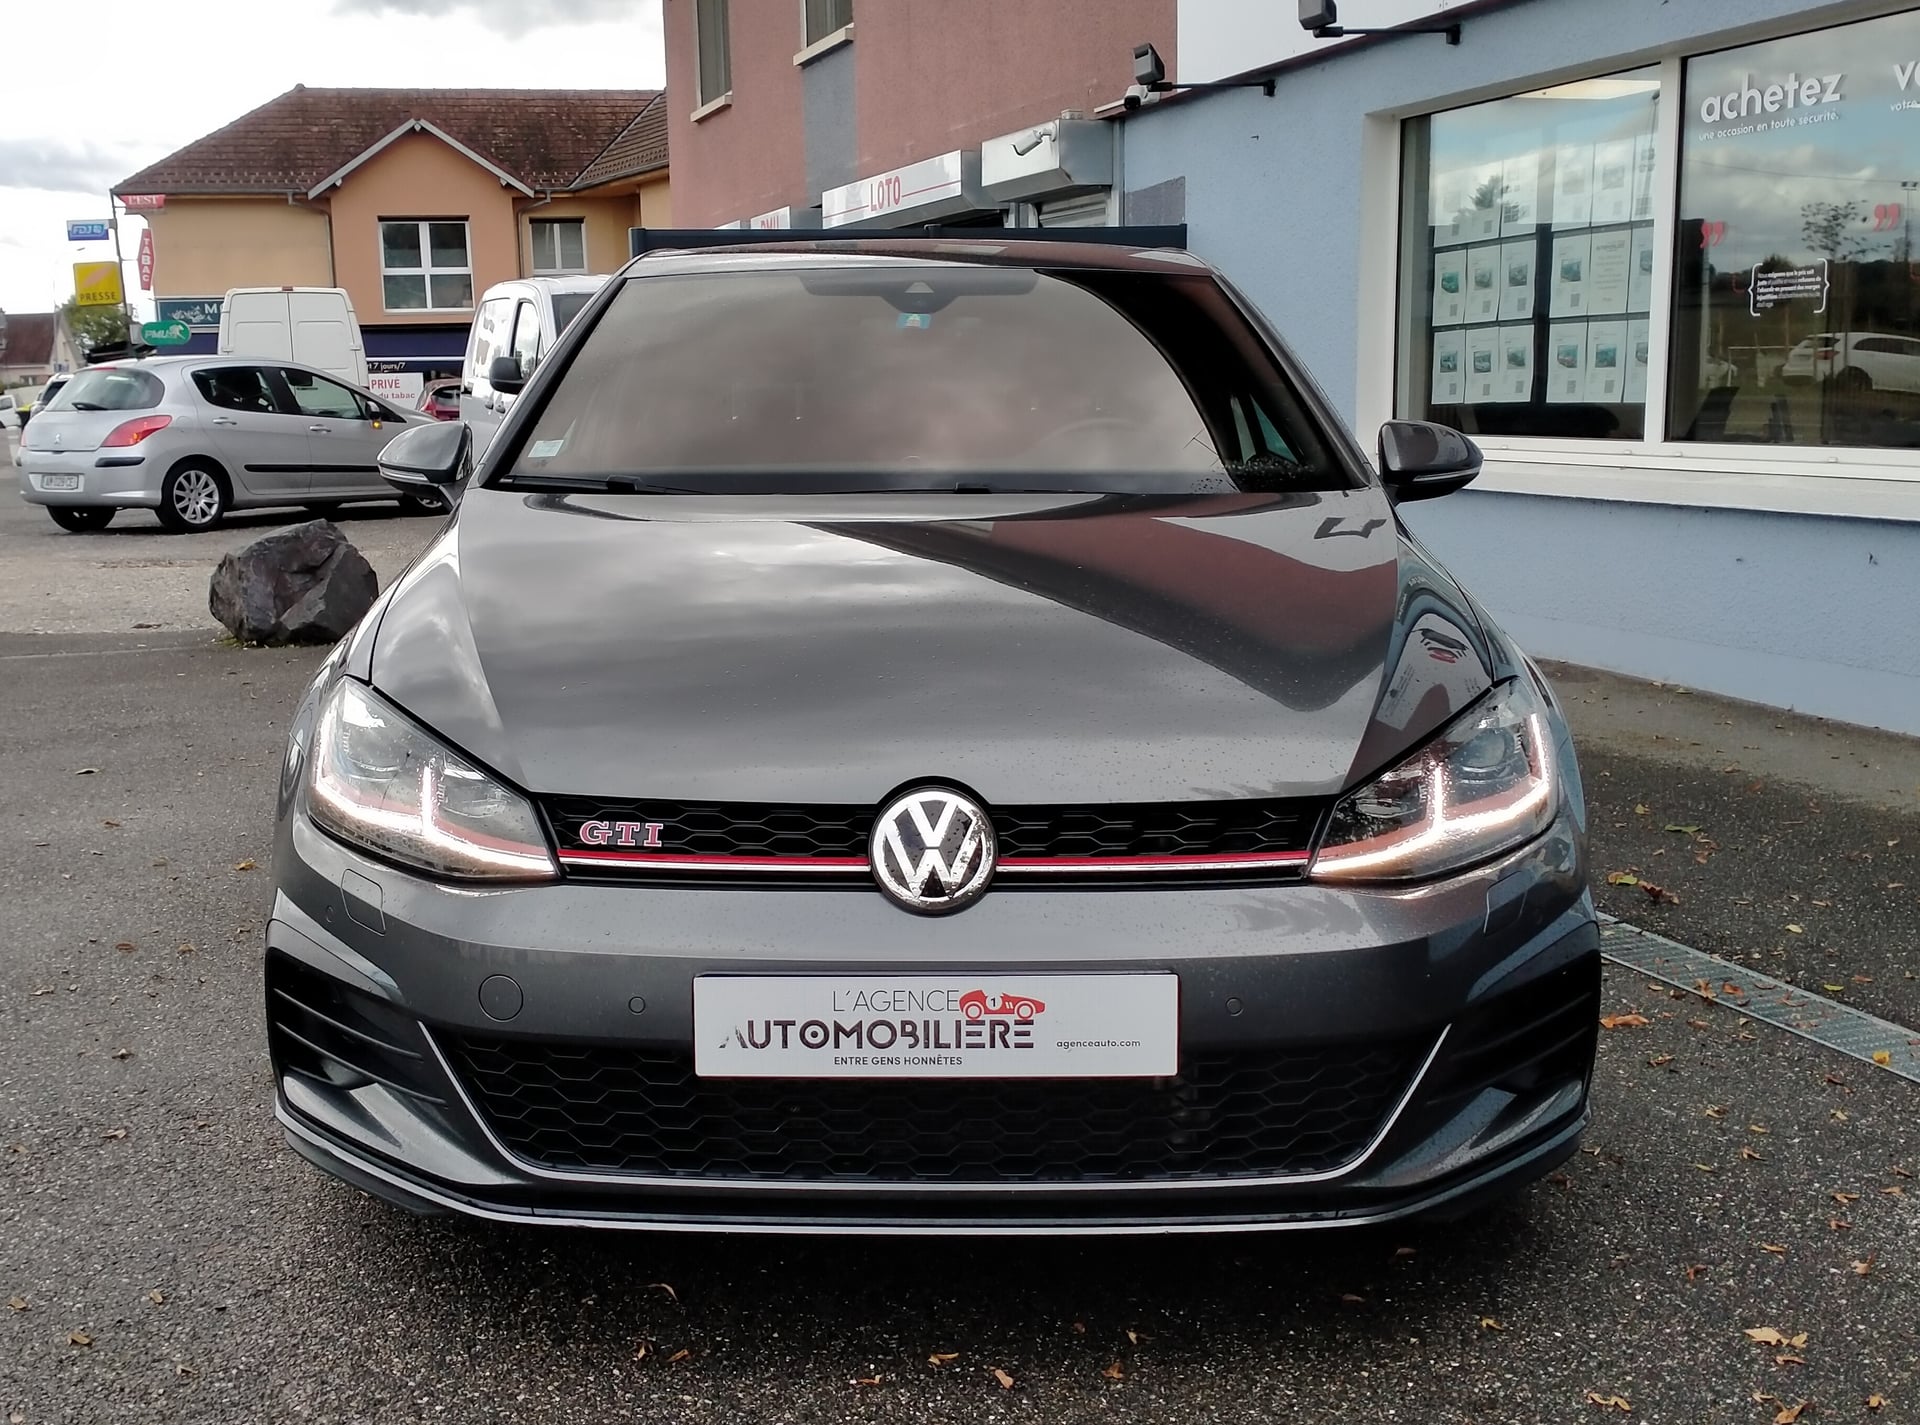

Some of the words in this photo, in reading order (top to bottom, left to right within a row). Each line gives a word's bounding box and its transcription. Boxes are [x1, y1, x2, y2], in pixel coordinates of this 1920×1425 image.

[1892, 61, 1920, 91] v
[1700, 72, 1843, 124] achetez
[1717, 123, 1754, 138] occasion
[1757, 123, 1768, 132] en
[1771, 117, 1796, 129] toute
[870, 175, 901, 212] LOTO
[72, 225, 92, 234] FDJ
[141, 237, 152, 283] TABAC
[79, 291, 117, 302] PRESSE
[145, 329, 169, 339] PMU
[371, 376, 400, 389] PRIVÉ
[391, 391, 415, 399] tabac
[579, 820, 664, 847] GTI
[833, 990, 960, 1012] L'AGENCE
[1056, 1039, 1141, 1050] agenceauto.com
[834, 1056, 869, 1066] ENTRE
[871, 1056, 901, 1066] GENS
[904, 1053, 963, 1066] HONNÊTES
